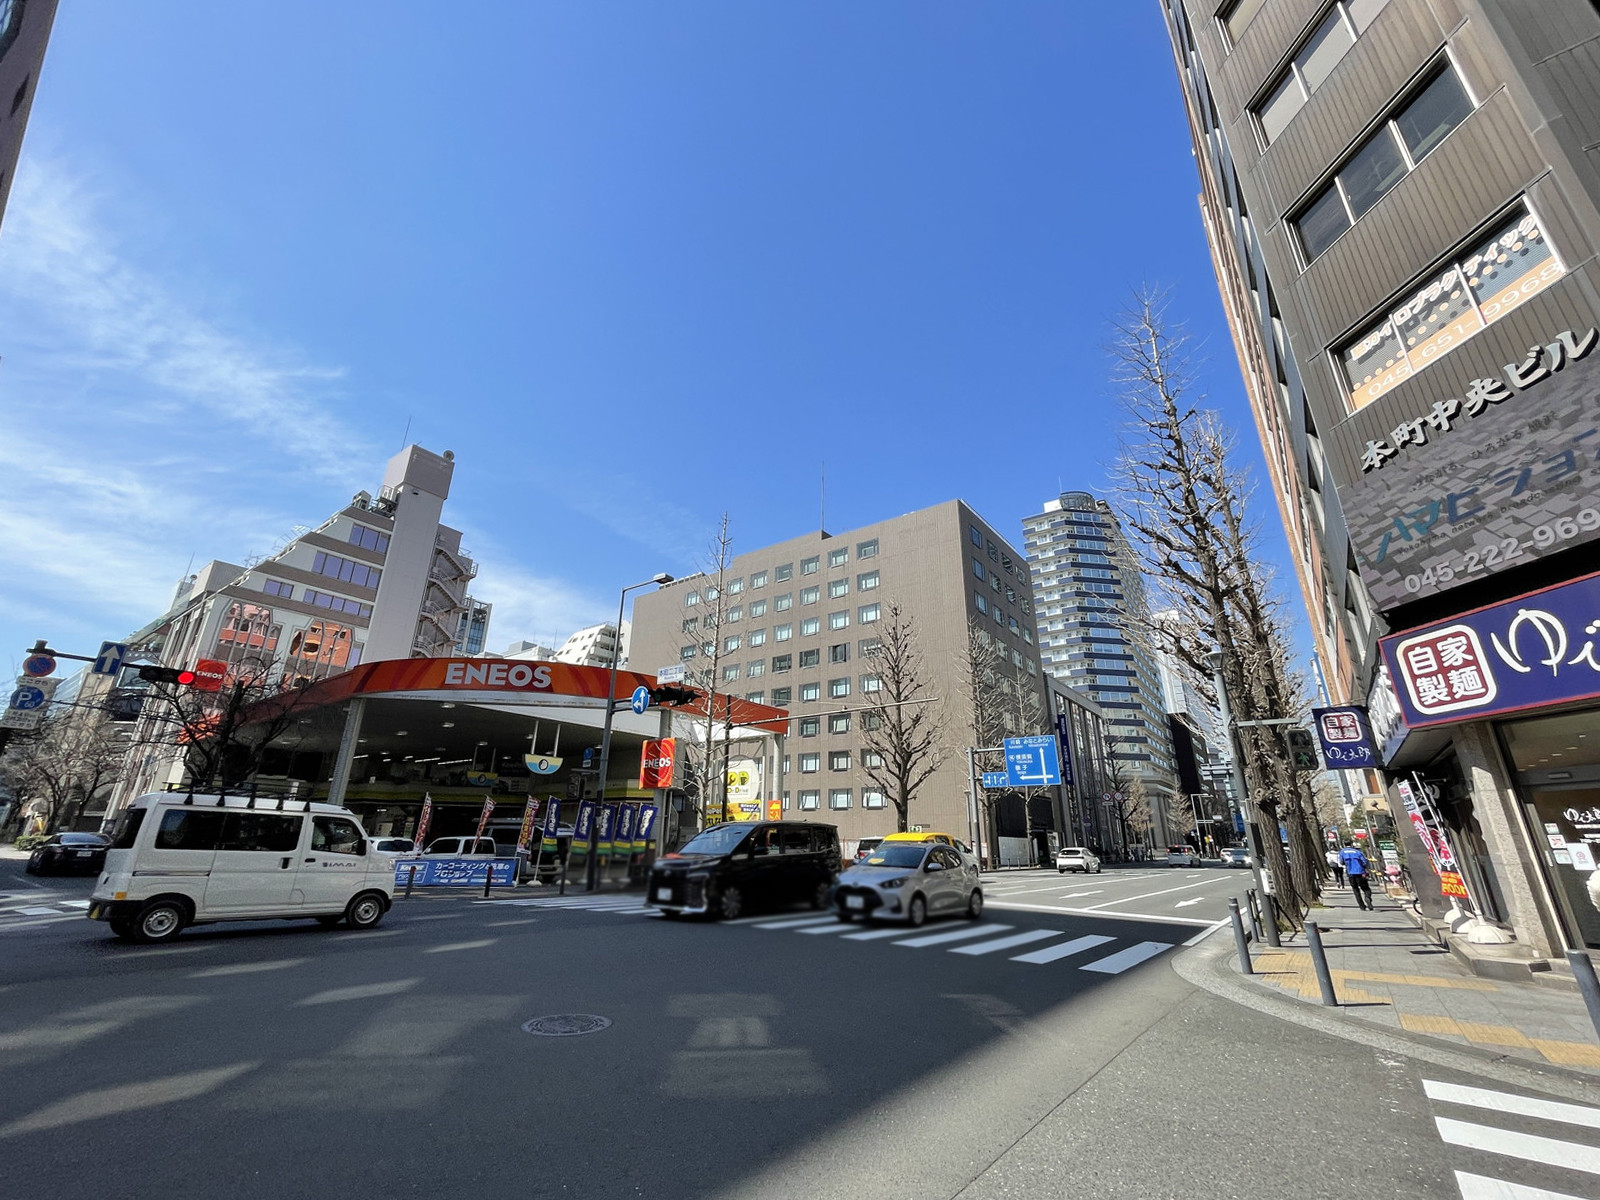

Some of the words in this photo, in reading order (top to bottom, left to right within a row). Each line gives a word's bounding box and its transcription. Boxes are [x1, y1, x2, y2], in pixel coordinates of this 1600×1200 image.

[1361, 327, 1600, 472] 本町中央ビル
[1408, 635, 1474, 676] 自家
[196, 670, 223, 680] ENEOS
[444, 662, 552, 688] ENEOS
[1416, 665, 1486, 706] 製麺
[16, 691, 32, 706] P
[643, 757, 672, 768] ENEOS
